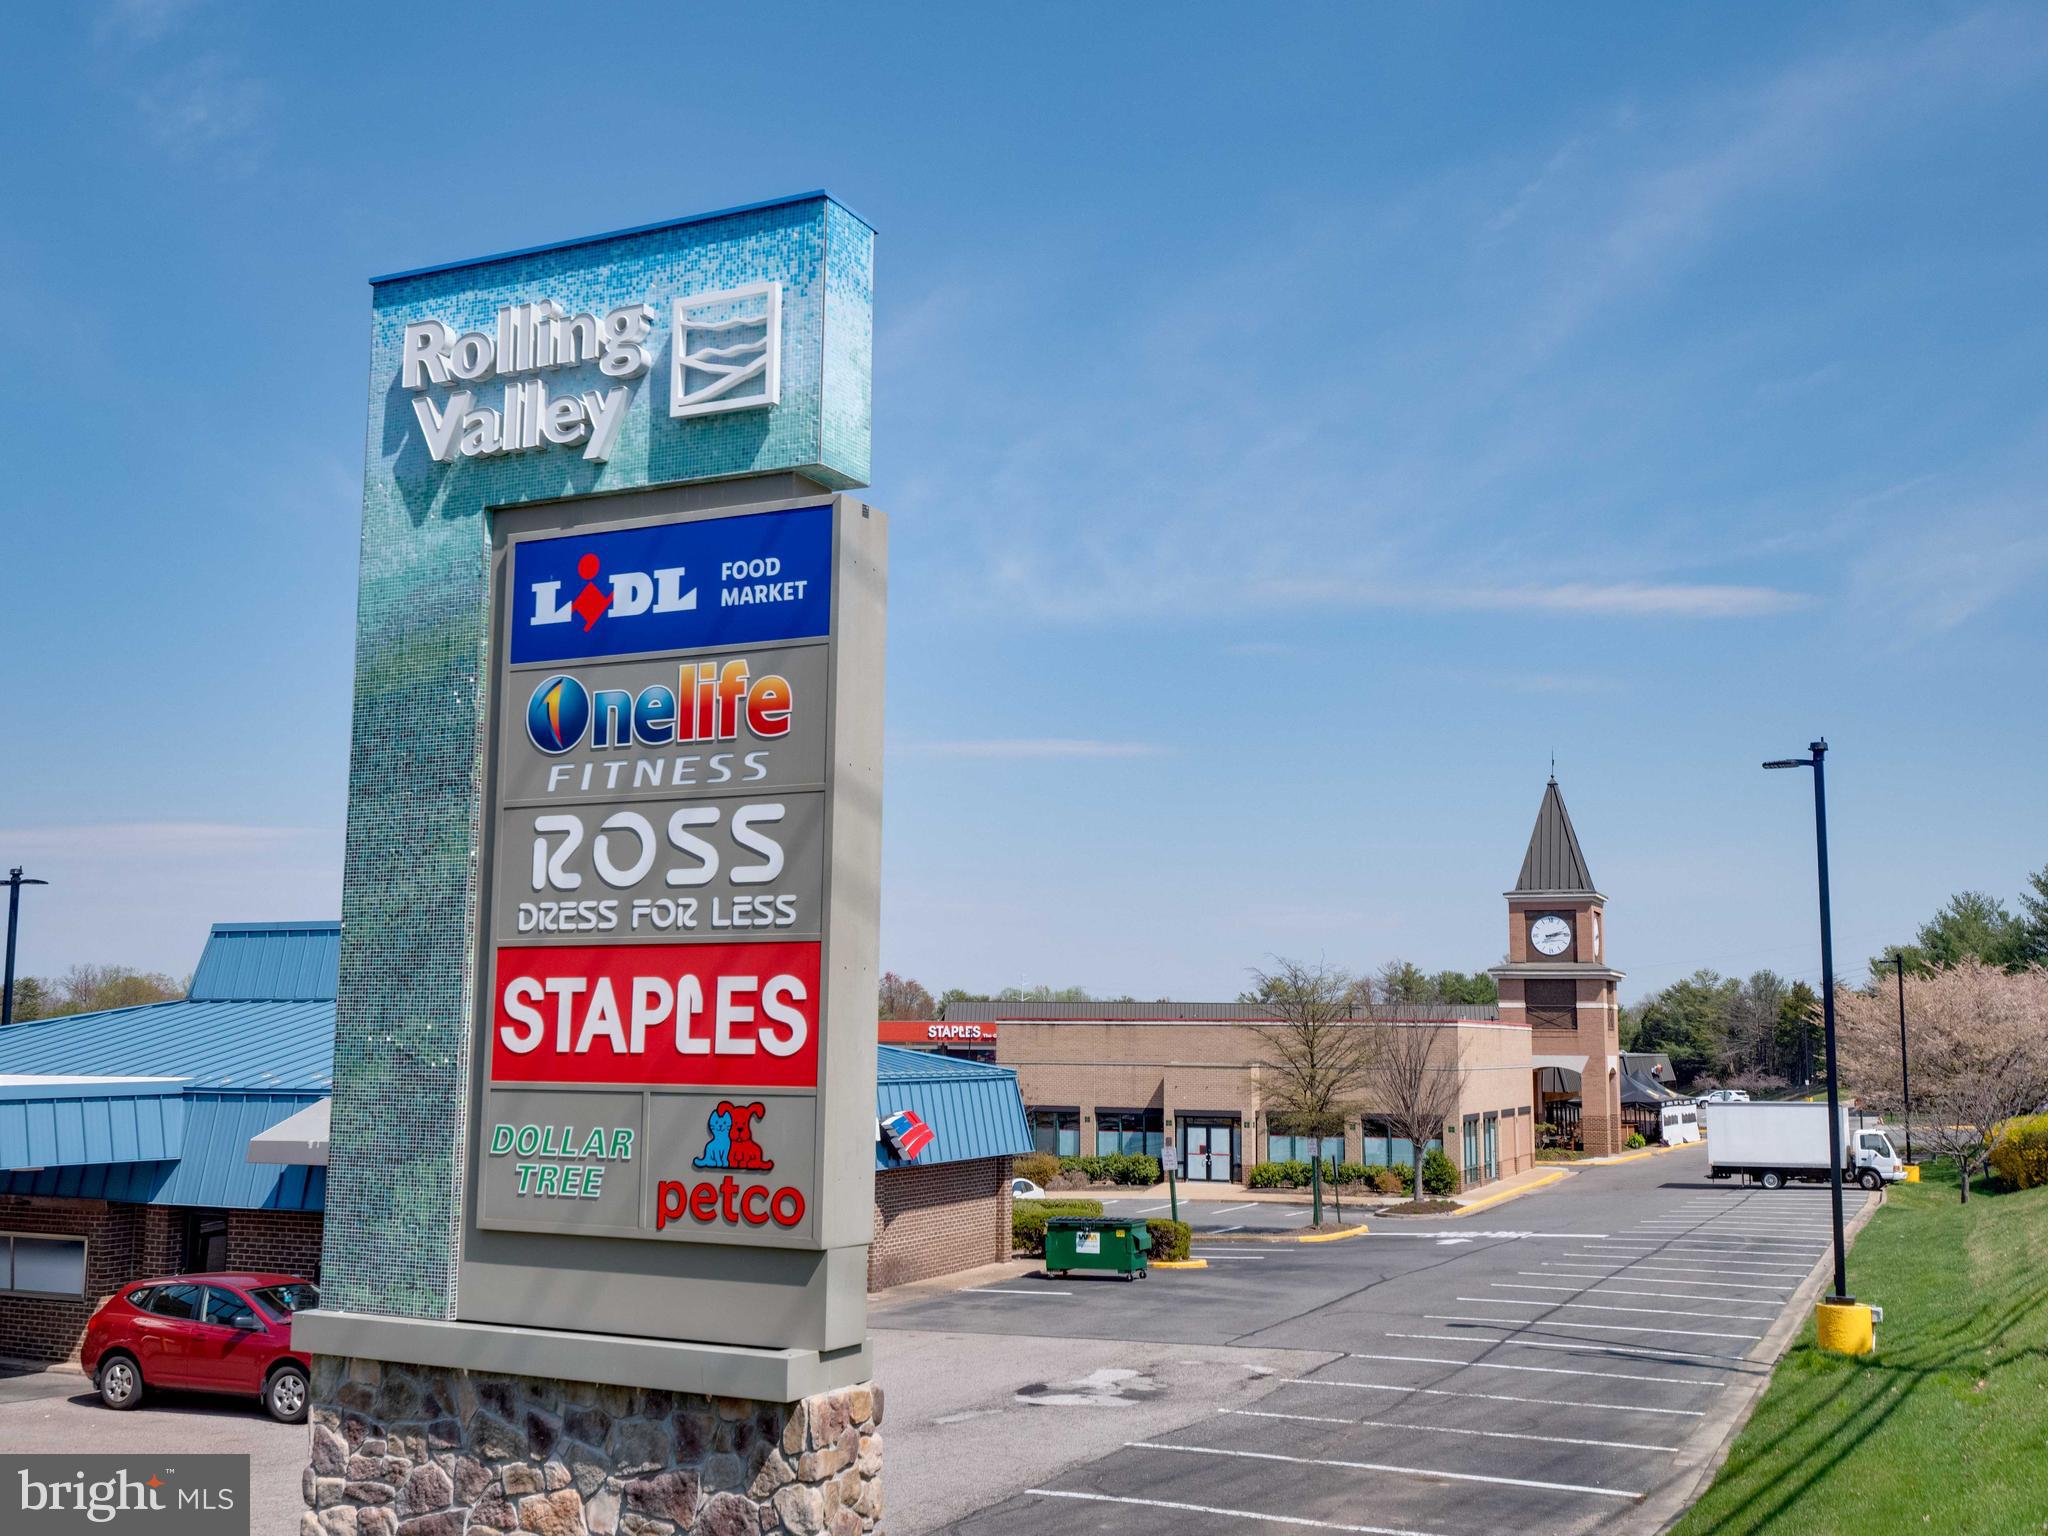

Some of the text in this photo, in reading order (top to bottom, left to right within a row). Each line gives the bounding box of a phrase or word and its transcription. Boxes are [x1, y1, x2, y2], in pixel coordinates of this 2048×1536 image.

[402, 299, 655, 390] Rolling
[412, 378, 631, 464] Valley
[721, 557, 781, 582] FOOD
[720, 580, 808, 608] MARKET
[526, 659, 793, 755] Onelife
[547, 751, 770, 792] FITNESS
[532, 803, 786, 890] ROSS
[518, 894, 798, 932] DRESS FOR LESS
[500, 973, 808, 1056] STAPLES
[928, 1025, 981, 1038] STAPLES
[490, 1123, 636, 1161] DOLLAR
[514, 1163, 606, 1199] TREE
[657, 1175, 806, 1230] petco
